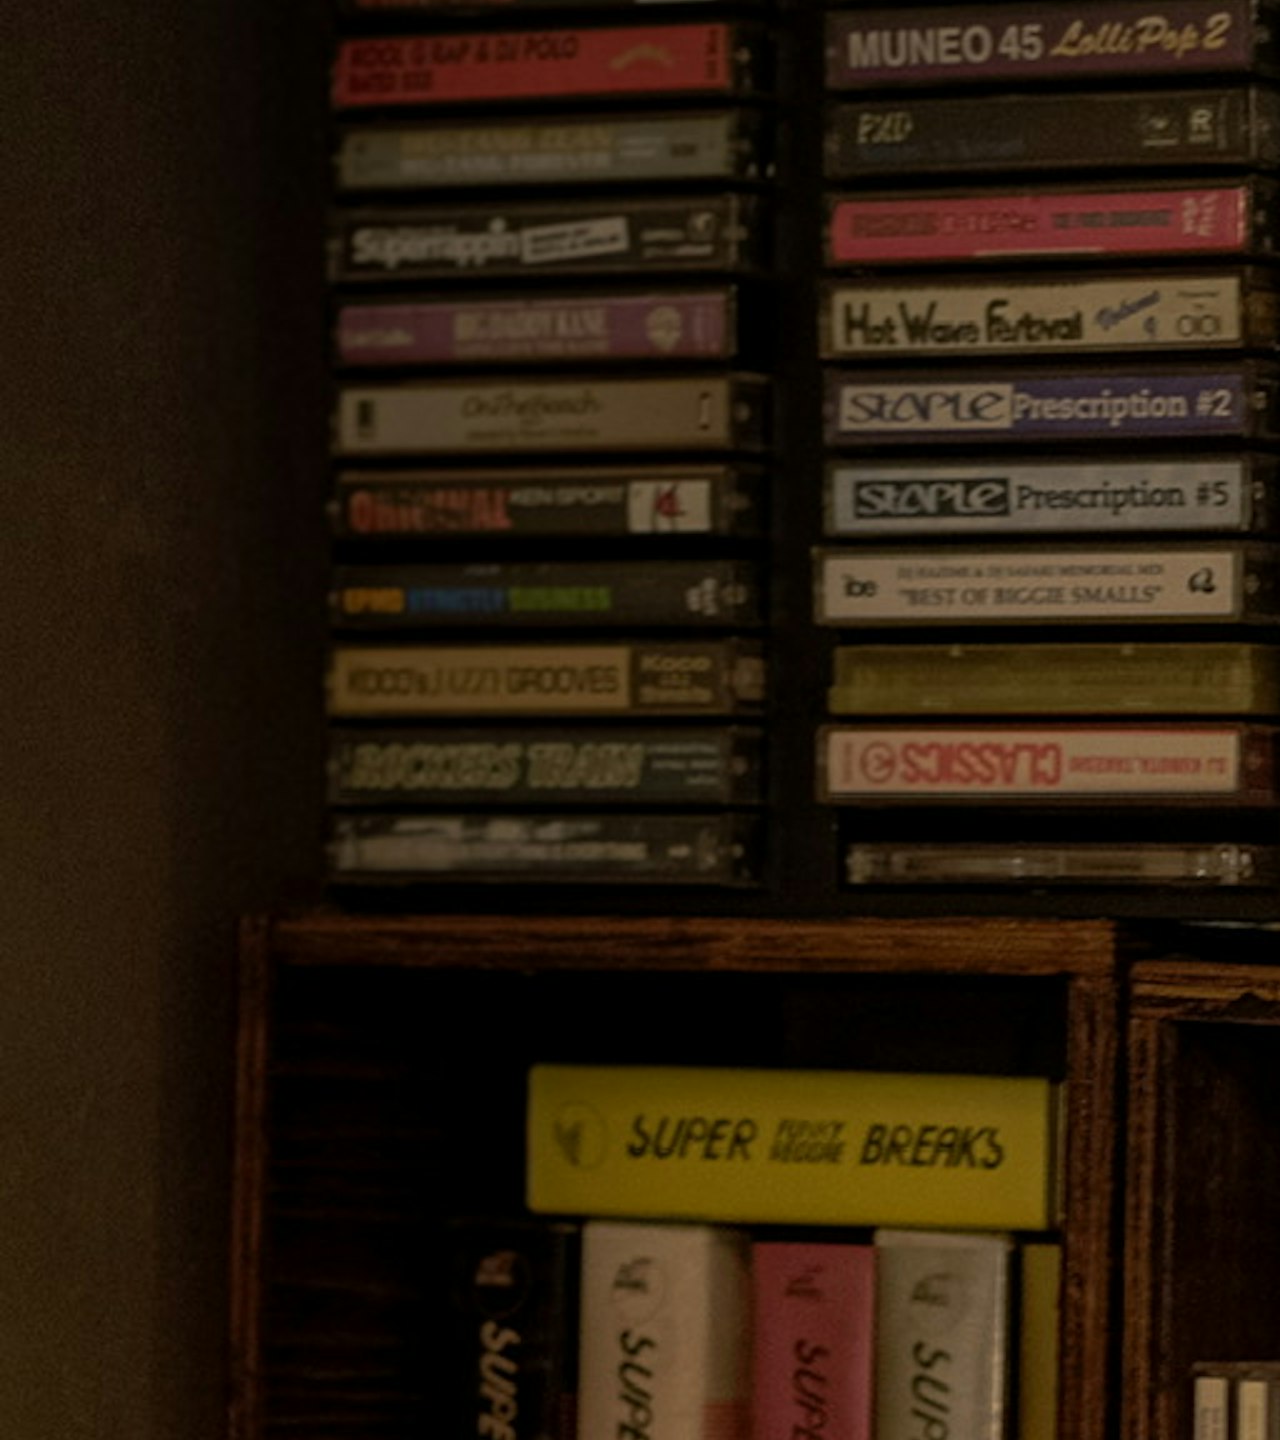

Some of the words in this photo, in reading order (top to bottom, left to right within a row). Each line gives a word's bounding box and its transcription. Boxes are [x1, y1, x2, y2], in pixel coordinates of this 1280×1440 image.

[1013, 392, 1189, 428] Prescription
[1196, 388, 1233, 418] #2
[1016, 484, 1187, 515] Prescription
[1195, 482, 1230, 508] #5
[901, 743, 1063, 787] CLASSICS
[627, 1115, 759, 1162] SUPER
[860, 1123, 1005, 1171] BREAKS
